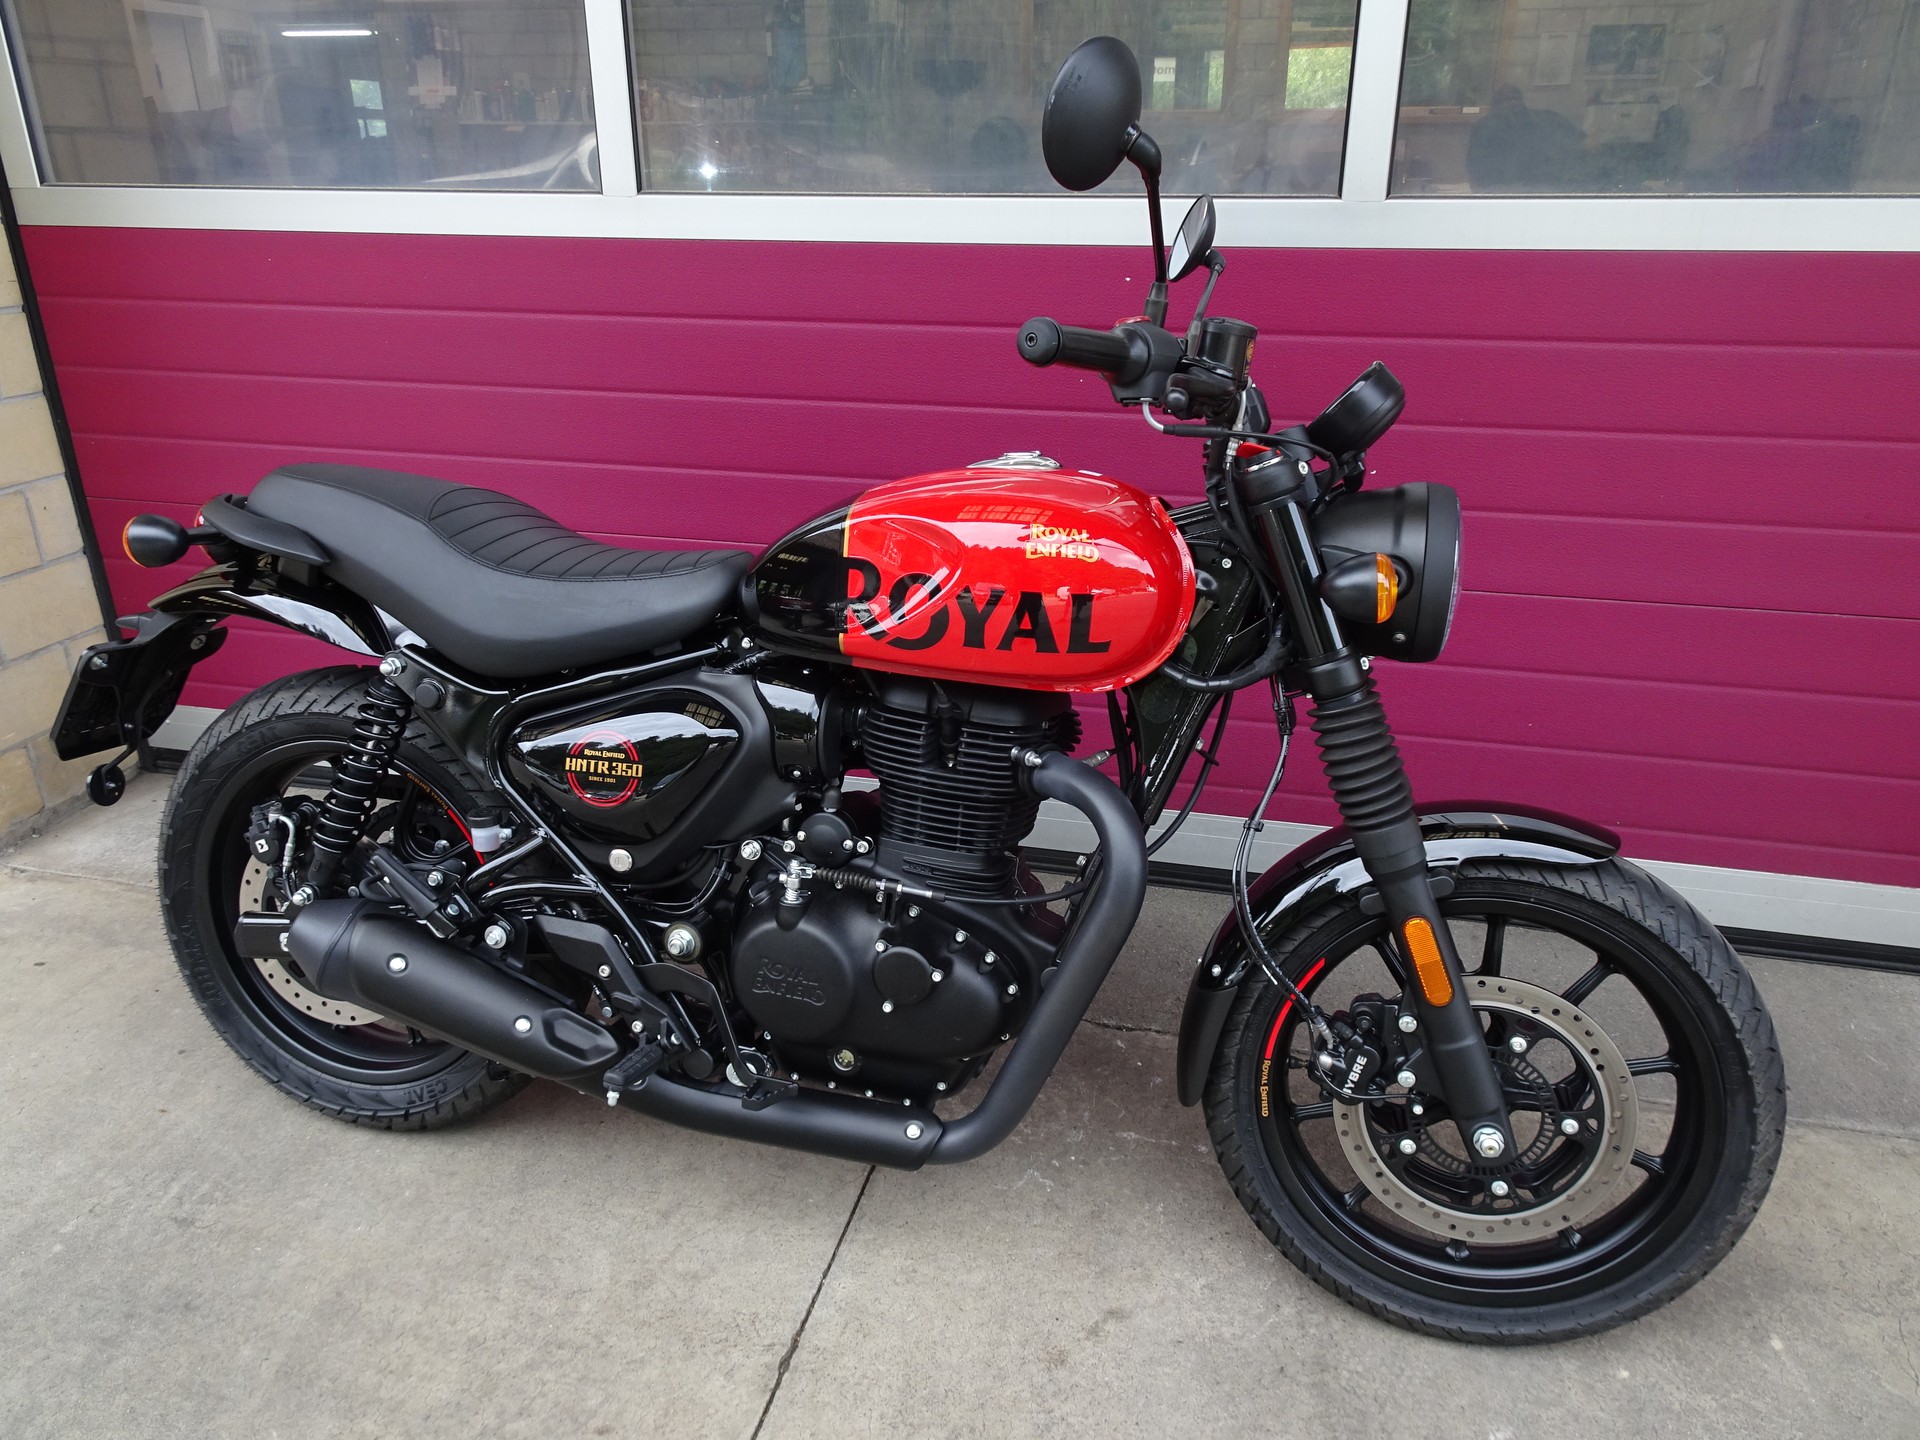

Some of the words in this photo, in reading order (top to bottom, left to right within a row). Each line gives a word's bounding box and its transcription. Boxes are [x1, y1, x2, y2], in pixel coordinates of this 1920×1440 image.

[1030, 523, 1093, 543] ROYAL
[1025, 541, 1100, 563] ENFIELD
[843, 555, 1112, 654] ROYAL
[583, 748, 602, 757] ROYAL
[602, 750, 626, 759] ENFIELD
[565, 757, 609, 775] HNTR
[611, 761, 643, 778] 350
[758, 959, 819, 986] ROYAL
[751, 981, 826, 1006] ENFIELD
[1261, 1059, 1272, 1086] ROYAL
[1260, 1085, 1270, 1117] ENFIELD
